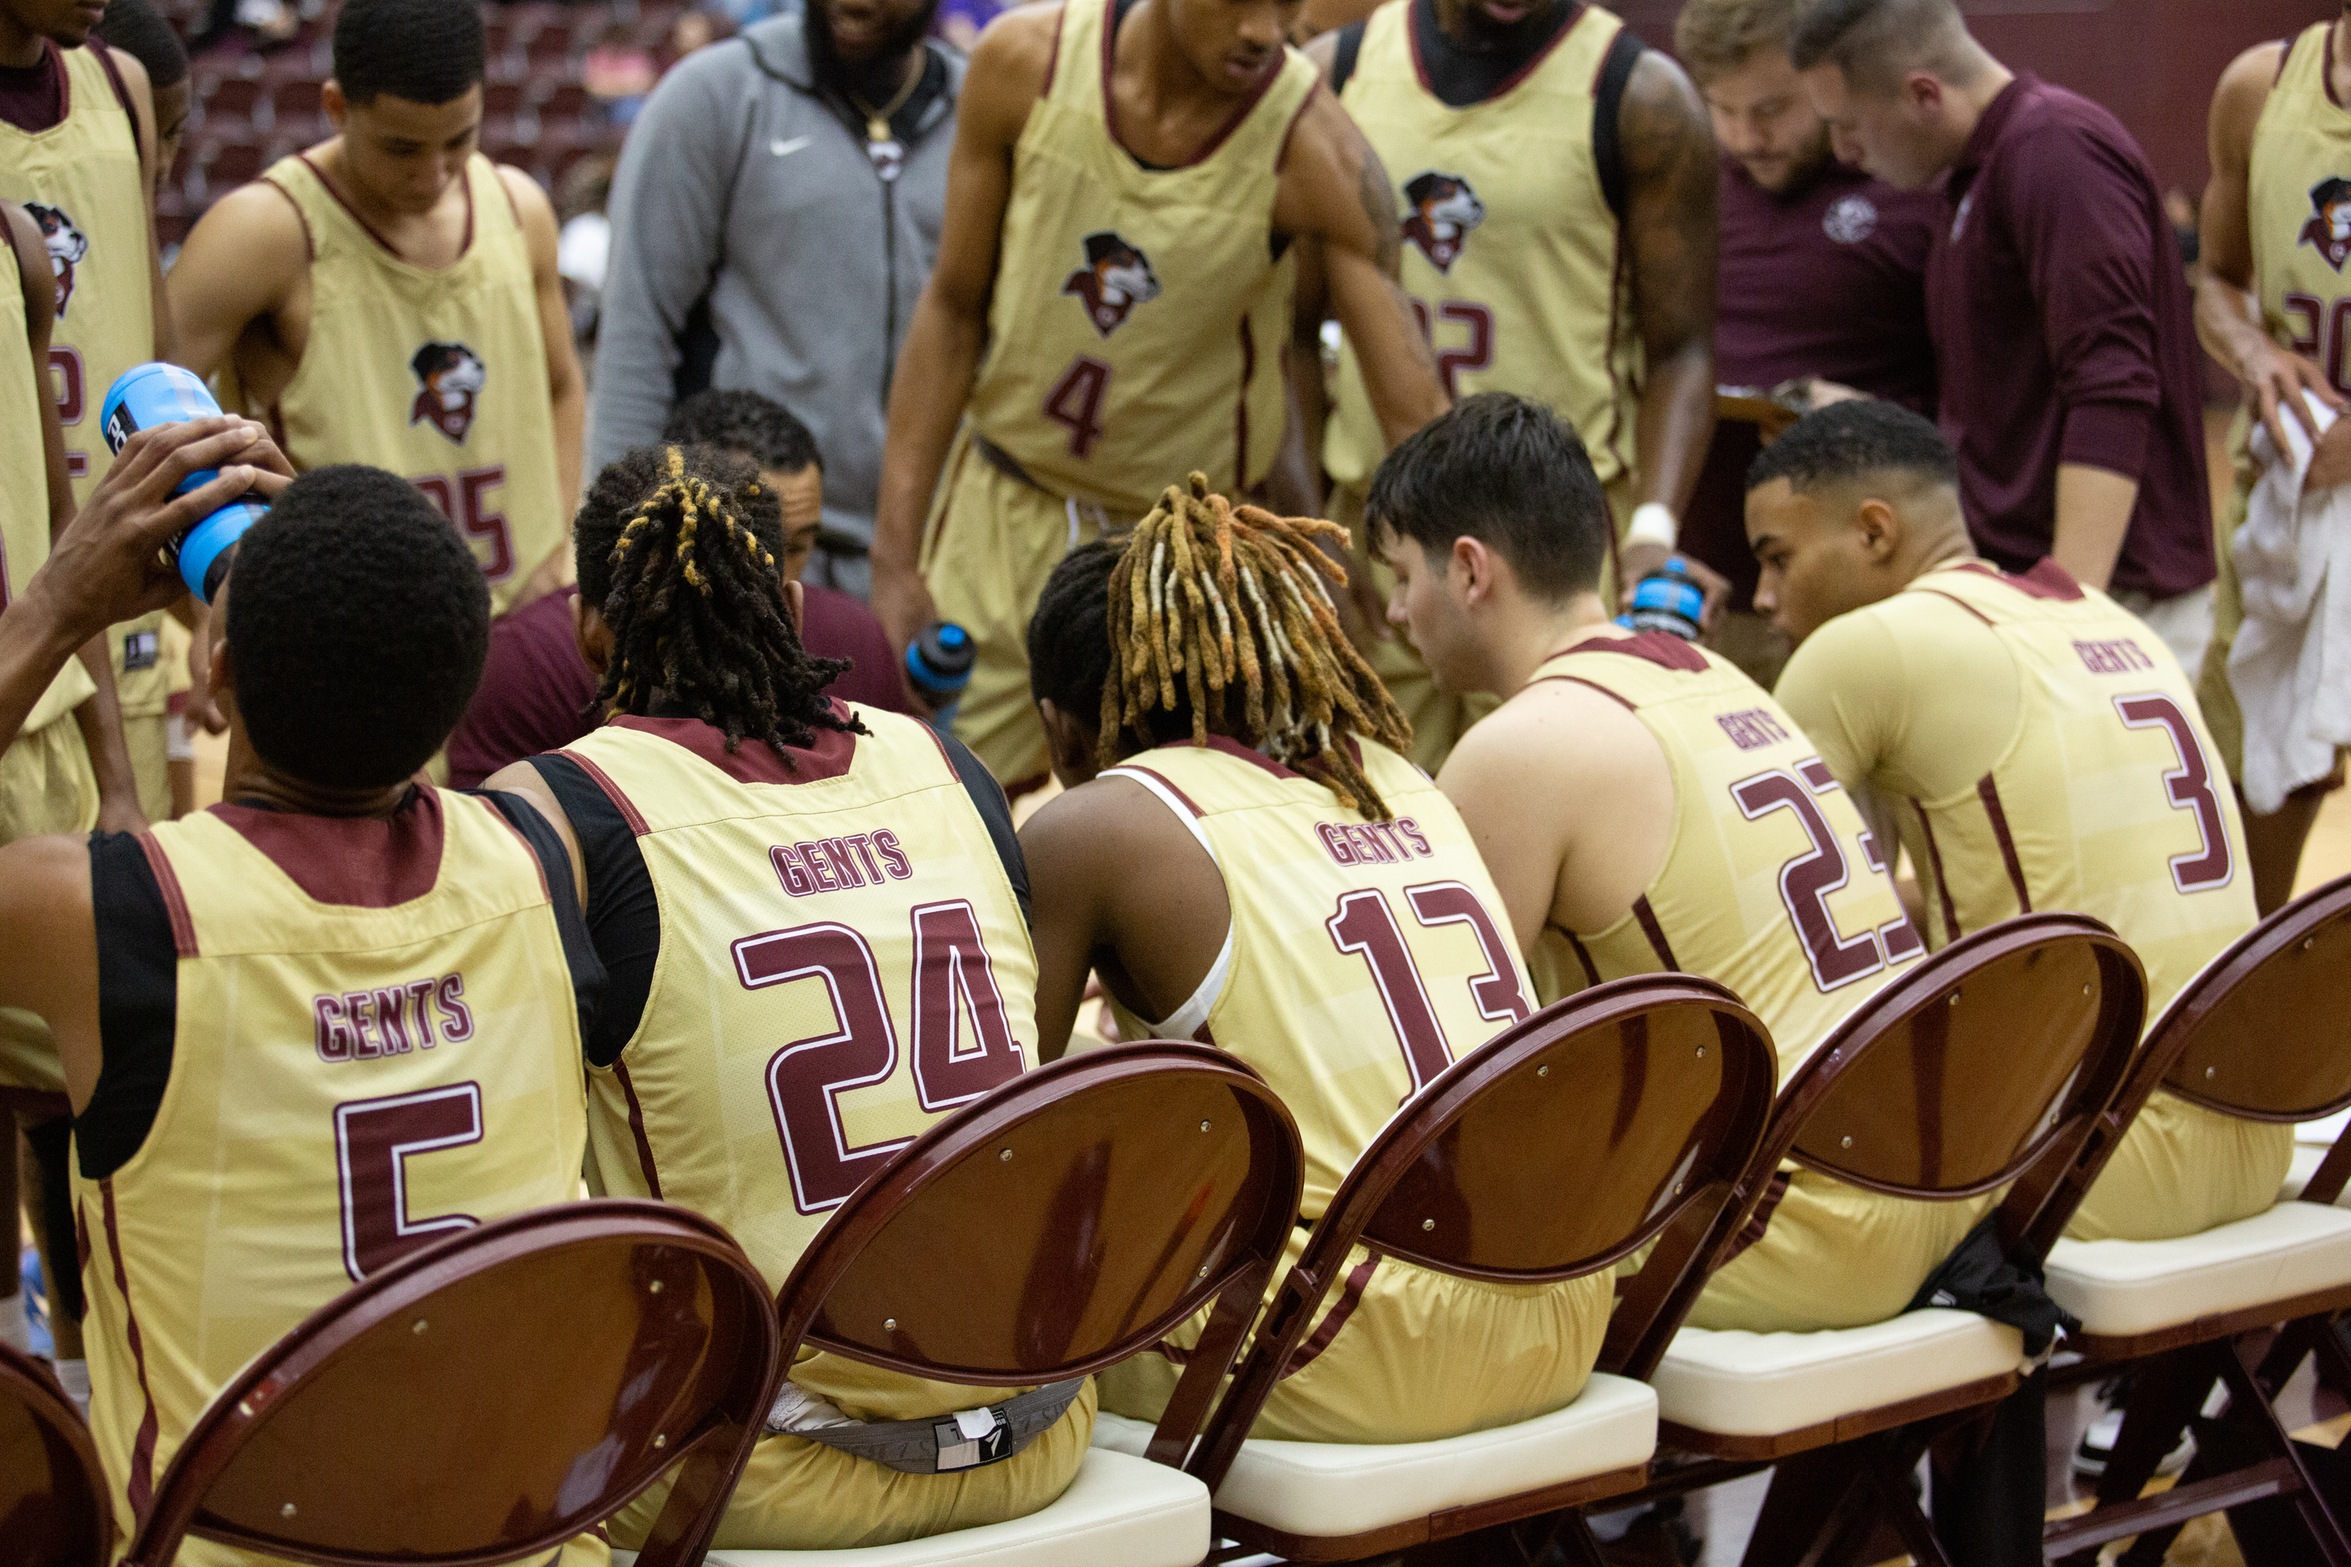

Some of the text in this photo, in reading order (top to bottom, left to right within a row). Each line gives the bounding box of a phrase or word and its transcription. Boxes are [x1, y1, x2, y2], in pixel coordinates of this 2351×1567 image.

[1408, 298, 1497, 403] 2
[1042, 353, 1113, 461] 4
[2070, 637, 2155, 675] GENTS
[1713, 707, 1792, 752] GENTS
[2111, 689, 2234, 894] 3
[768, 828, 913, 898] GENTS
[1314, 816, 1435, 867] GENTS
[314, 973, 475, 1063] GENTS
[1325, 880, 1532, 1108] 13
[730, 898, 1027, 1216] 24
